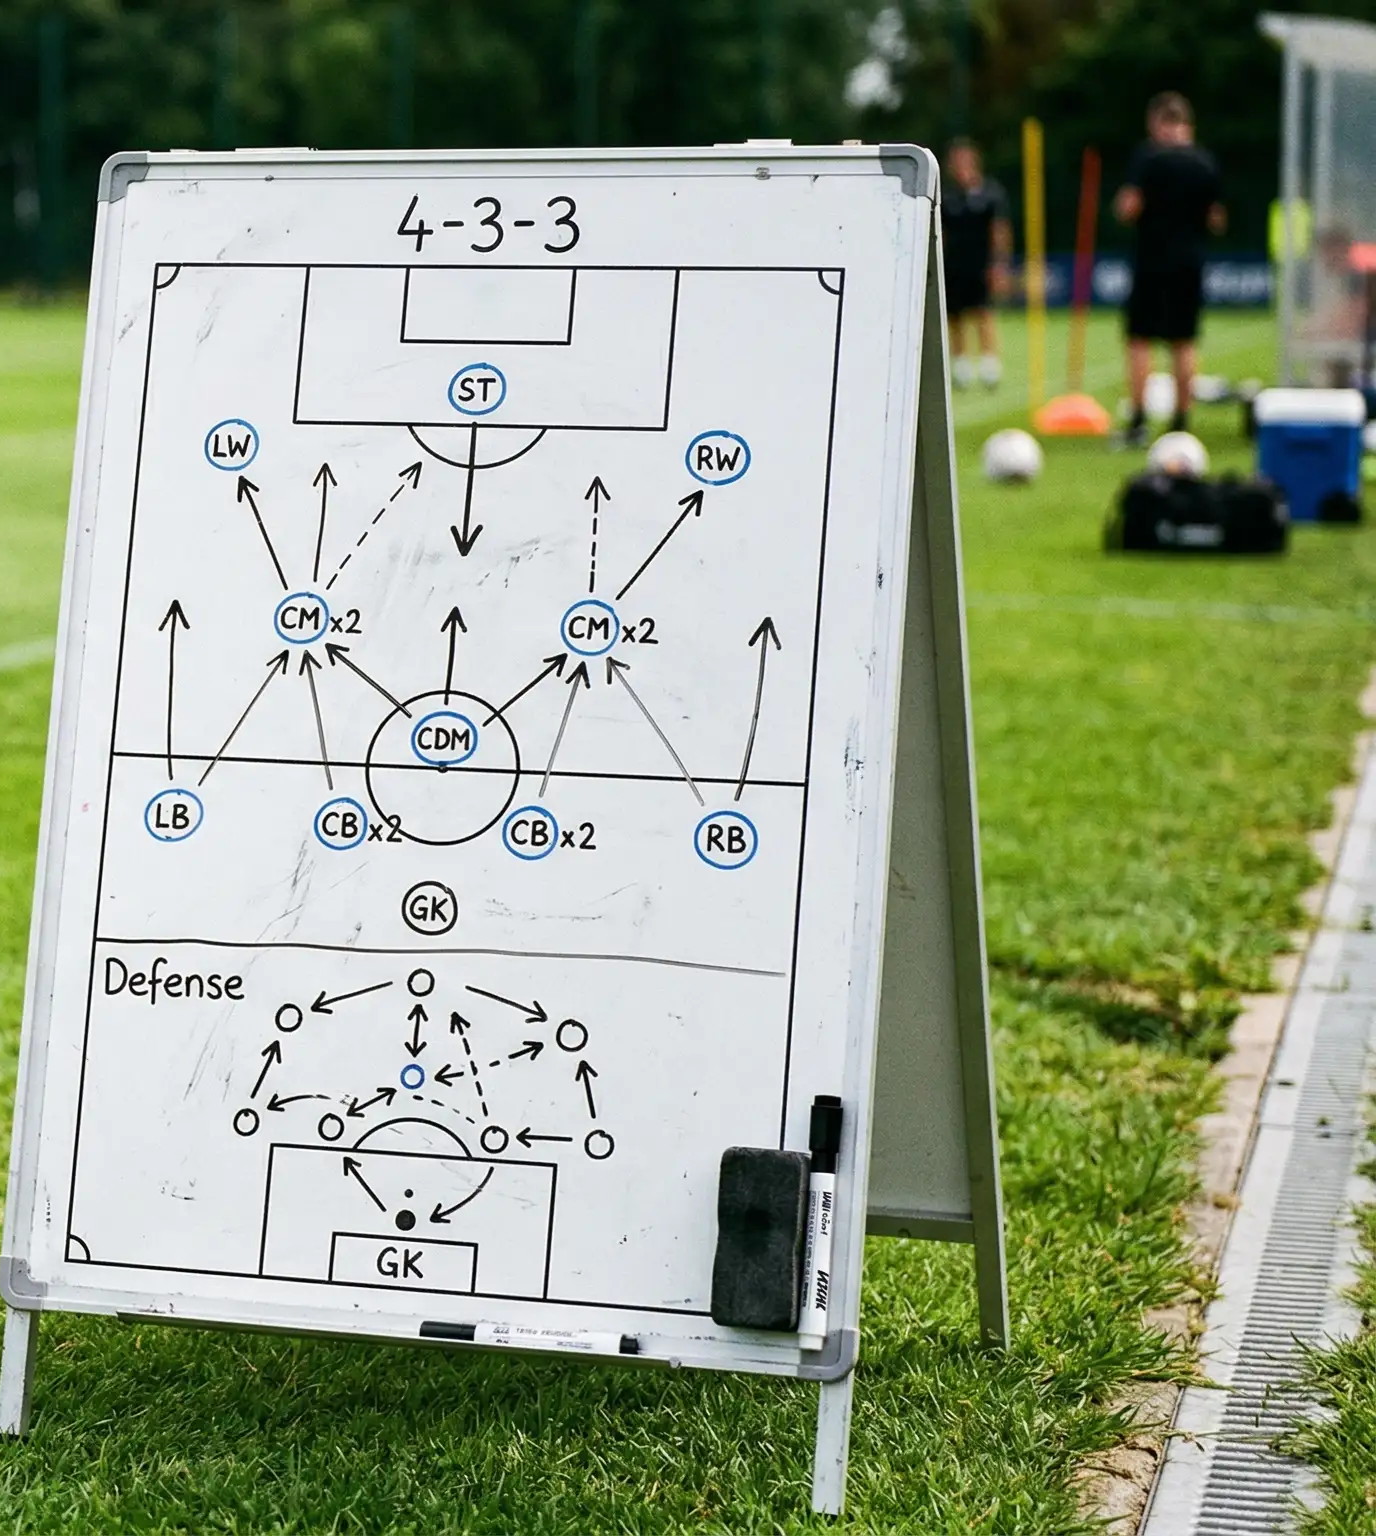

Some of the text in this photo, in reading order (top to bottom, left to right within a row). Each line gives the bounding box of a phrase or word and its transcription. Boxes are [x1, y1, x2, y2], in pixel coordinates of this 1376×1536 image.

[396, 195, 580, 254] 4-3-3
[457, 377, 497, 402] ST
[212, 433, 252, 458] LW
[697, 444, 741, 472] RW
[280, 606, 363, 634] CM x2
[568, 615, 659, 645] CM x2
[417, 726, 470, 751] CDM
[155, 802, 190, 830] LB
[321, 811, 403, 843] CB x2
[510, 819, 597, 850] CB x2
[706, 823, 747, 854] RB
[409, 894, 449, 923] GK
[104, 957, 245, 1005] Defense
[376, 1246, 424, 1279] GK
